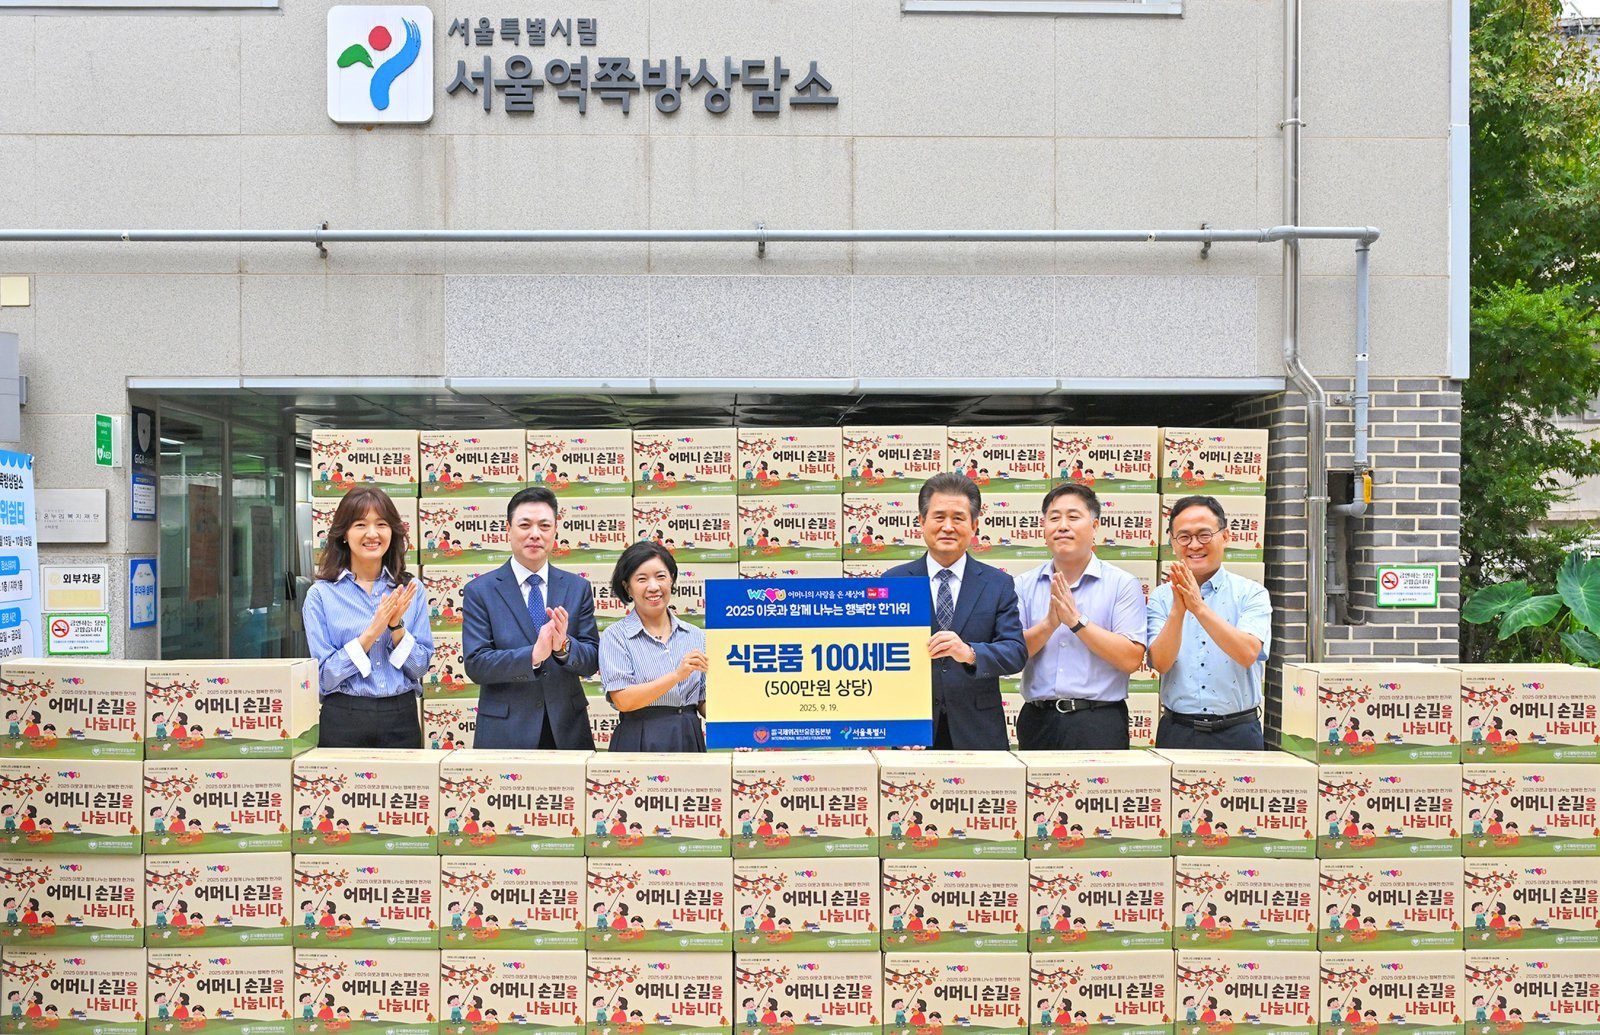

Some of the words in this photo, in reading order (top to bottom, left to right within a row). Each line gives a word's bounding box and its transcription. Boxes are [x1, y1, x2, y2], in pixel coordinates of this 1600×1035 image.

[446, 55, 839, 114] 서울역쪽방상담소
[103, 451, 111, 460] AED
[347, 452, 379, 464] 어머니
[382, 452, 410, 464] 손길을
[562, 452, 593, 464] 어머니
[596, 452, 624, 464] 손길을
[772, 450, 804, 462] 어머니
[807, 450, 835, 462] 손길을
[878, 448, 909, 460] 어머니
[912, 448, 940, 460] 손길을
[1088, 449, 1120, 461] 어머니
[1122, 449, 1151, 461] 손길을
[1199, 450, 1230, 462] 어머니
[1233, 451, 1261, 463] 손길을
[374, 466, 411, 476] 나눕니다
[588, 465, 624, 475] 나눕니다
[799, 463, 835, 473] 나눕니다
[904, 462, 940, 471] 나눕니다
[1114, 462, 1151, 472] 나눕니다
[1224, 464, 1261, 475] 나눕니다
[668, 518, 699, 530] 어머니
[702, 518, 730, 530] 손길을
[773, 517, 804, 529] 어머니
[879, 515, 910, 527] 어머니
[694, 531, 730, 541] 나눕니다
[63, 573, 101, 584] 외부차량
[788, 590, 814, 598] 어머니의
[815, 590, 835, 598] 사랑을
[837, 590, 844, 598] 온
[845, 590, 865, 598] 세상에
[725, 606, 754, 617] 2025
[757, 604, 788, 616] 이웃과
[790, 604, 811, 616] 함께
[813, 603, 843, 616] 나누는
[845, 603, 876, 616] 행복한
[878, 603, 911, 616] 한가위
[726, 644, 803, 673] 식료품
[811, 643, 911, 672] 100세트
[765, 680, 831, 697] (500만원
[836, 679, 872, 697] 상당)
[48, 696, 92, 714] 어머니
[96, 698, 136, 715] 손길을
[194, 697, 238, 713] 어머니
[243, 696, 282, 713] 손길을
[800, 704, 818, 712] 2025.
[820, 704, 827, 712] 9.
[829, 704, 839, 712] 19.
[1366, 702, 1409, 718] 어머니
[1413, 702, 1452, 718] 손길을
[1509, 702, 1553, 718] 어머니
[1557, 702, 1596, 718] 손길을
[85, 716, 136, 732] 나눕니다
[232, 715, 282, 729] 나눕니다
[1402, 721, 1452, 734] 나눕니다
[1546, 720, 1596, 734] 나눕니다
[852, 728, 886, 736] 서울특별시
[193, 791, 237, 807] 어머니
[242, 790, 281, 807] 손길을
[341, 791, 386, 808] 어머니
[389, 792, 430, 809] 손길을
[634, 794, 678, 811] 어머니
[682, 795, 722, 812] 손길을
[780, 794, 824, 810] 어머니
[828, 794, 868, 810] 손길을
[1074, 796, 1118, 813] 어머니
[1122, 796, 1161, 812] 손길을
[1366, 795, 1409, 812] 어머니
[1413, 795, 1452, 812] 손길을
[1510, 794, 1553, 811] 어머니
[1557, 795, 1596, 811] 손길을
[230, 809, 282, 823] 나눕니다
[378, 810, 429, 825] 나눕니다
[671, 814, 722, 828] 나눕니다
[817, 813, 868, 827] 나눕니다
[1111, 814, 1161, 828] 나눕니다
[1403, 814, 1452, 828] 나눕니다
[1546, 813, 1596, 827] 나눕니다
[343, 886, 387, 903] 어머니
[391, 887, 431, 904] 손길을
[782, 890, 826, 906] 어머니
[830, 890, 870, 906] 손길을
[1224, 888, 1267, 905] 어머니
[1271, 889, 1311, 906] 손길을
[1367, 889, 1411, 905] 어머니
[1415, 889, 1454, 905] 손길을
[380, 905, 431, 920] 나눕니다
[820, 908, 870, 922] 나눕니다
[1260, 908, 1310, 922] 나눕니다
[1404, 908, 1454, 921] 나눕니다
[196, 977, 240, 994] 어머니
[244, 977, 284, 993] 손길을
[784, 983, 828, 999] 어머니
[832, 982, 872, 999] 손길을
[1078, 982, 1121, 999] 어머니
[1126, 981, 1164, 998] 손길을
[234, 996, 284, 1009] 나눕니다
[822, 1001, 872, 1015] 나눕니다
[1115, 1000, 1164, 1014] 나눕니다
